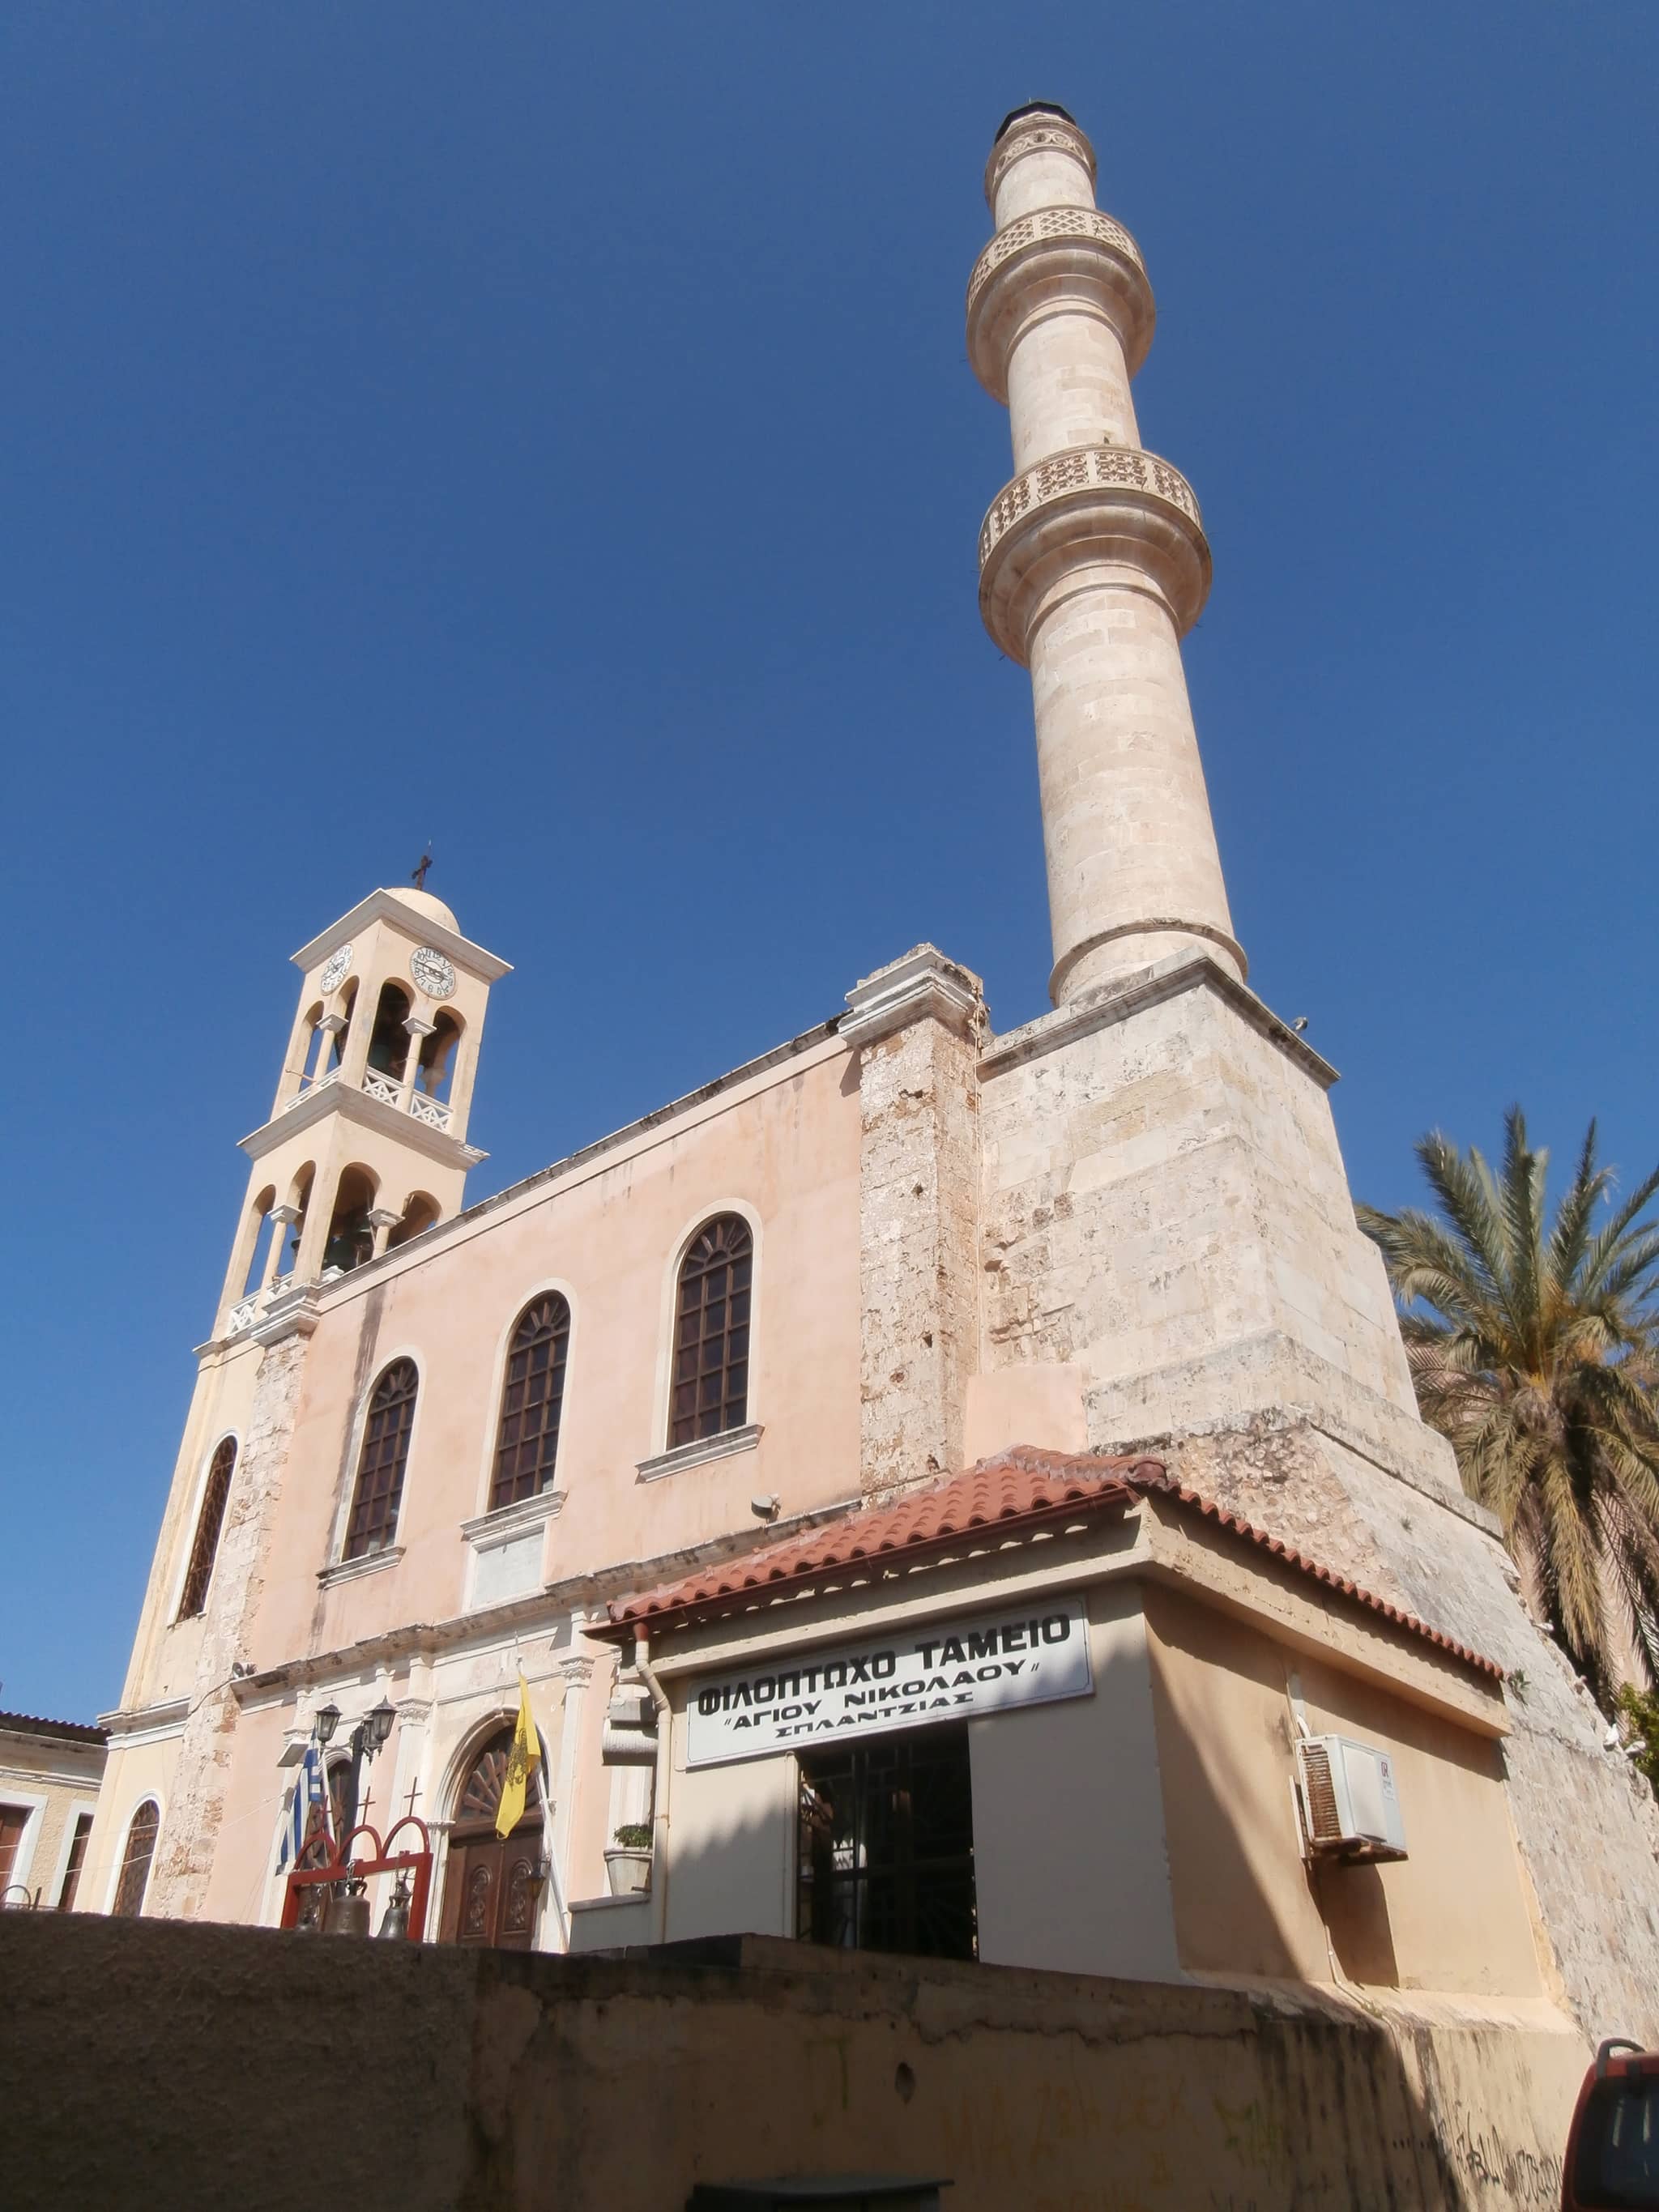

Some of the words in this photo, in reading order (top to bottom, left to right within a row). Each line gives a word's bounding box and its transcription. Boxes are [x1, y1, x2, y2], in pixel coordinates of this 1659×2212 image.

[698, 1651, 897, 1715] ΦΙΛΟΠΤΩΧΟ
[915, 1613, 1071, 1670] ΤΑΜΕΙΟ
[775, 1692, 974, 1738] ΣΠΛΑΝΤΖΙΑΣ
